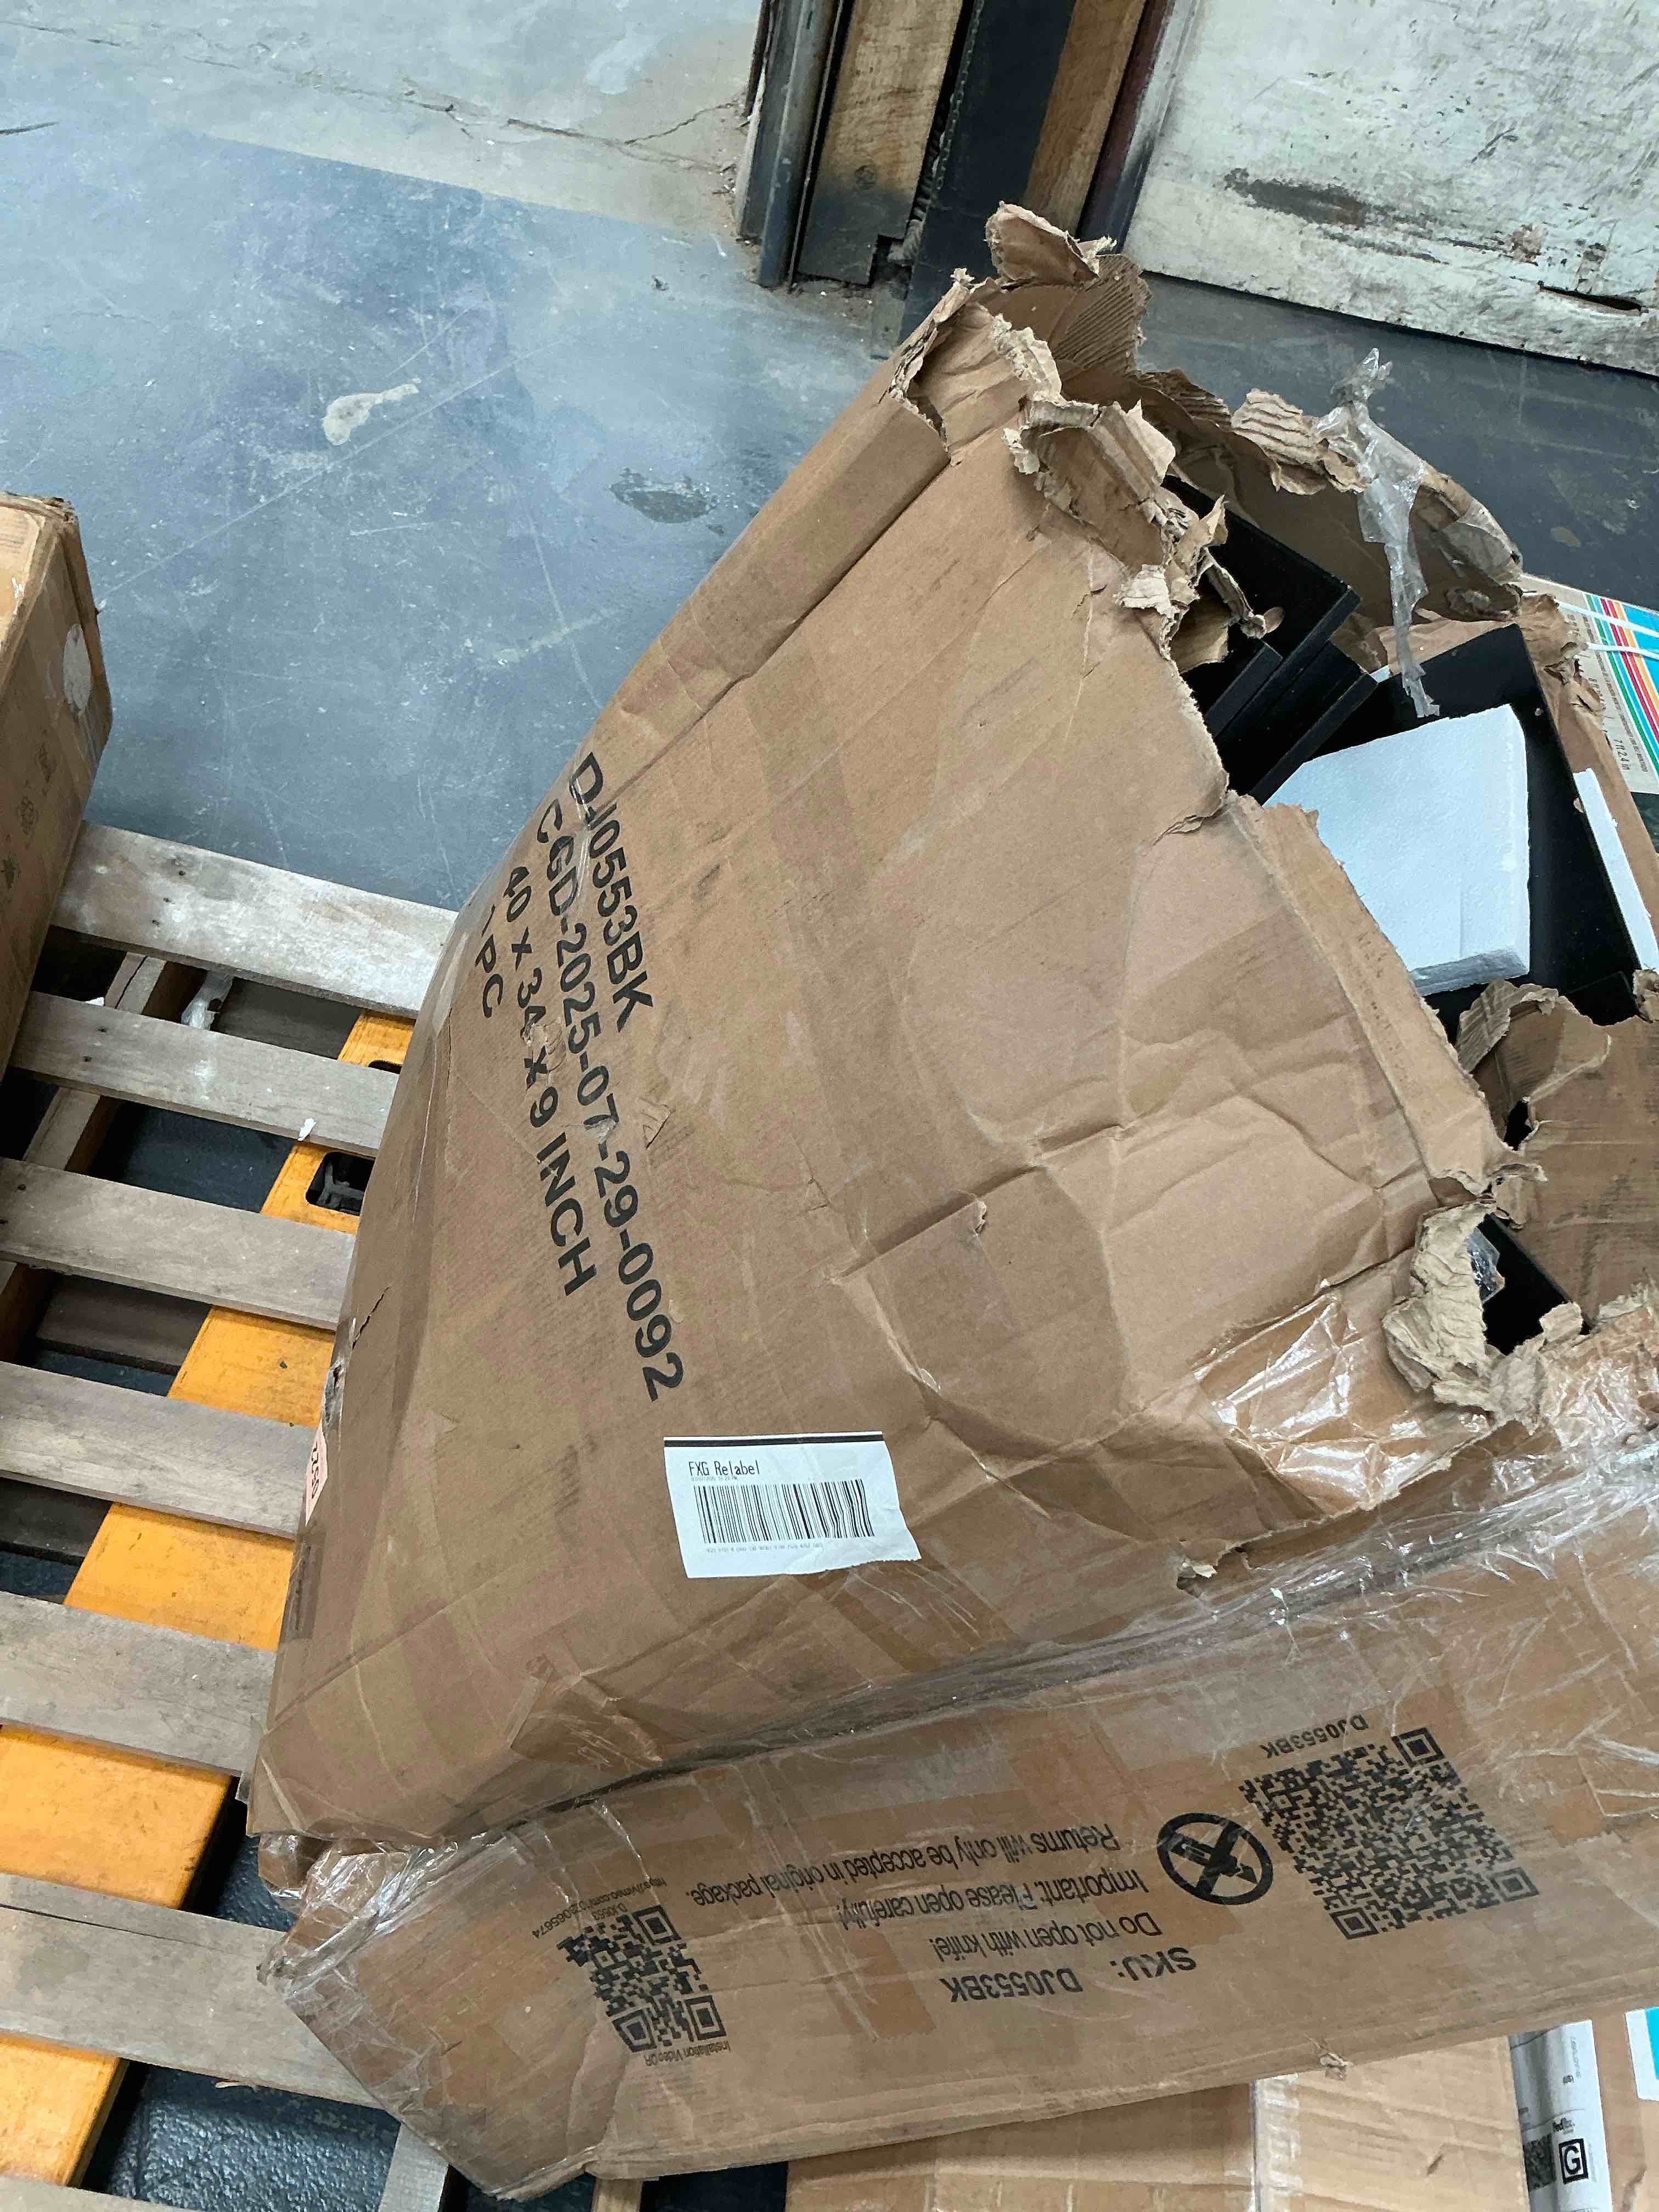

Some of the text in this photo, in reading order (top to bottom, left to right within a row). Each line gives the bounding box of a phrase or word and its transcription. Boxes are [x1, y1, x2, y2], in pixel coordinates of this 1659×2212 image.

[569, 752, 653, 1032] DJ0553BK
[503, 866, 597, 1296] 40 x 34 x 9 INCH
[537, 799, 684, 1401] CGD-2025-07-29-0092
[689, 1459, 760, 1476] FXG Relabel
[1259, 1714, 1369, 1758] DJ0553BK
[686, 1824, 1121, 1906] Returns will only be accepted in original package.
[836, 1867, 1149, 1931] Important: Please open carefully!
[930, 1912, 1163, 1962] Do not open with knife!
[940, 1947, 1197, 2002] SKU: DJ0553BK
[683, 2040, 731, 2057] Installation
[1563, 2145, 1581, 2175] G
